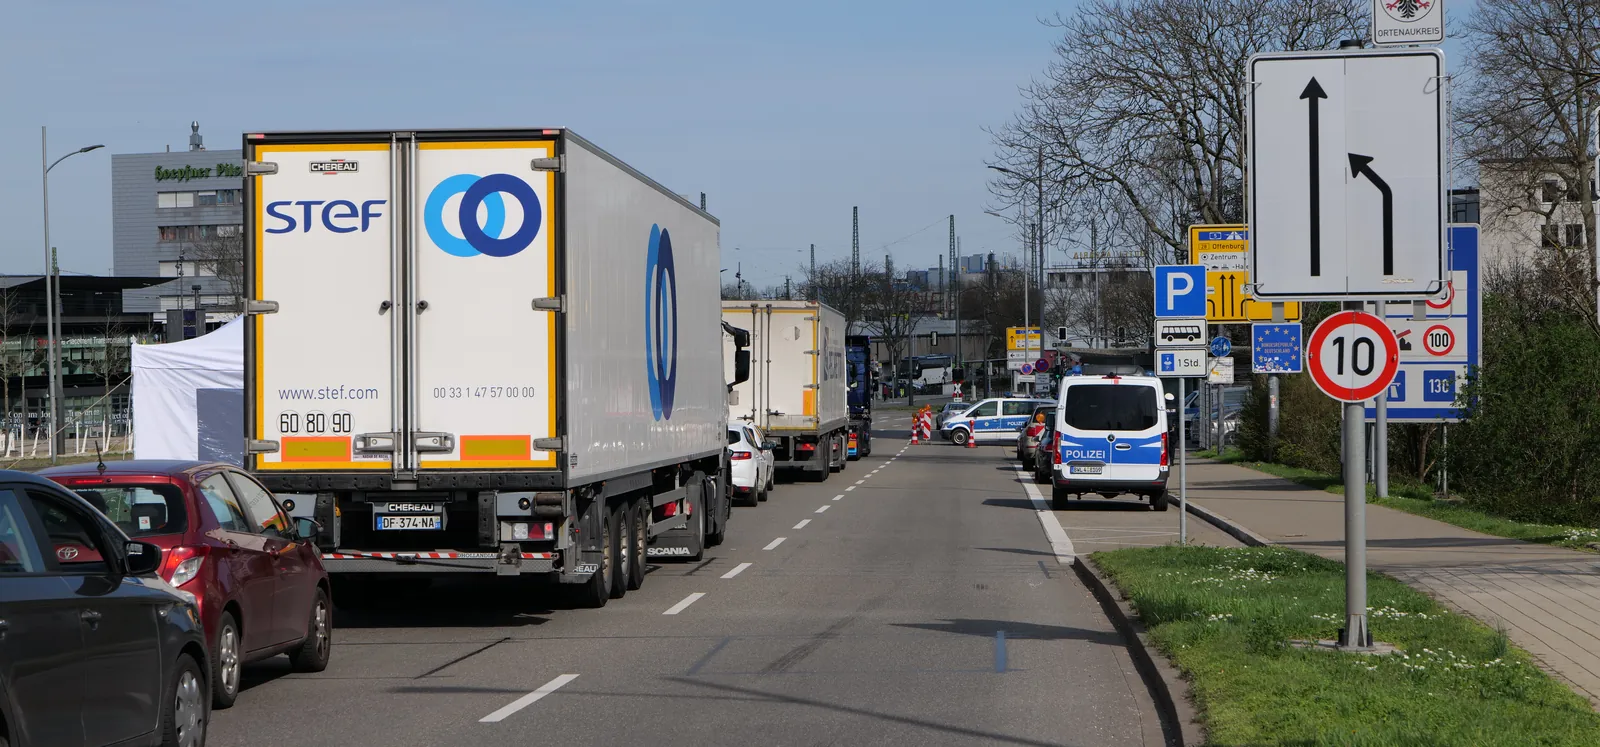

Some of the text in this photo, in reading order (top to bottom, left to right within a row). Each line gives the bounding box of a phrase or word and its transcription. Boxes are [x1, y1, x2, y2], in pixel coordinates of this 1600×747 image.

[1378, 27, 1439, 37] ORTENAUKREIS
[216, 163, 243, 177] Pils
[311, 163, 357, 171] CHEREAU
[1167, 272, 1194, 310] P
[1429, 333, 1449, 347] 100
[1178, 358, 1201, 367] 1 Std.
[1332, 336, 1375, 376] 10
[278, 386, 379, 400] www.stef.com
[433, 387, 535, 399] 00 33 1 47 57 00 00
[1428, 379, 1449, 393] 130
[280, 413, 351, 433] 60 80 90
[1066, 450, 1106, 459] POLIZEI
[647, 547, 690, 555] SCANIA
